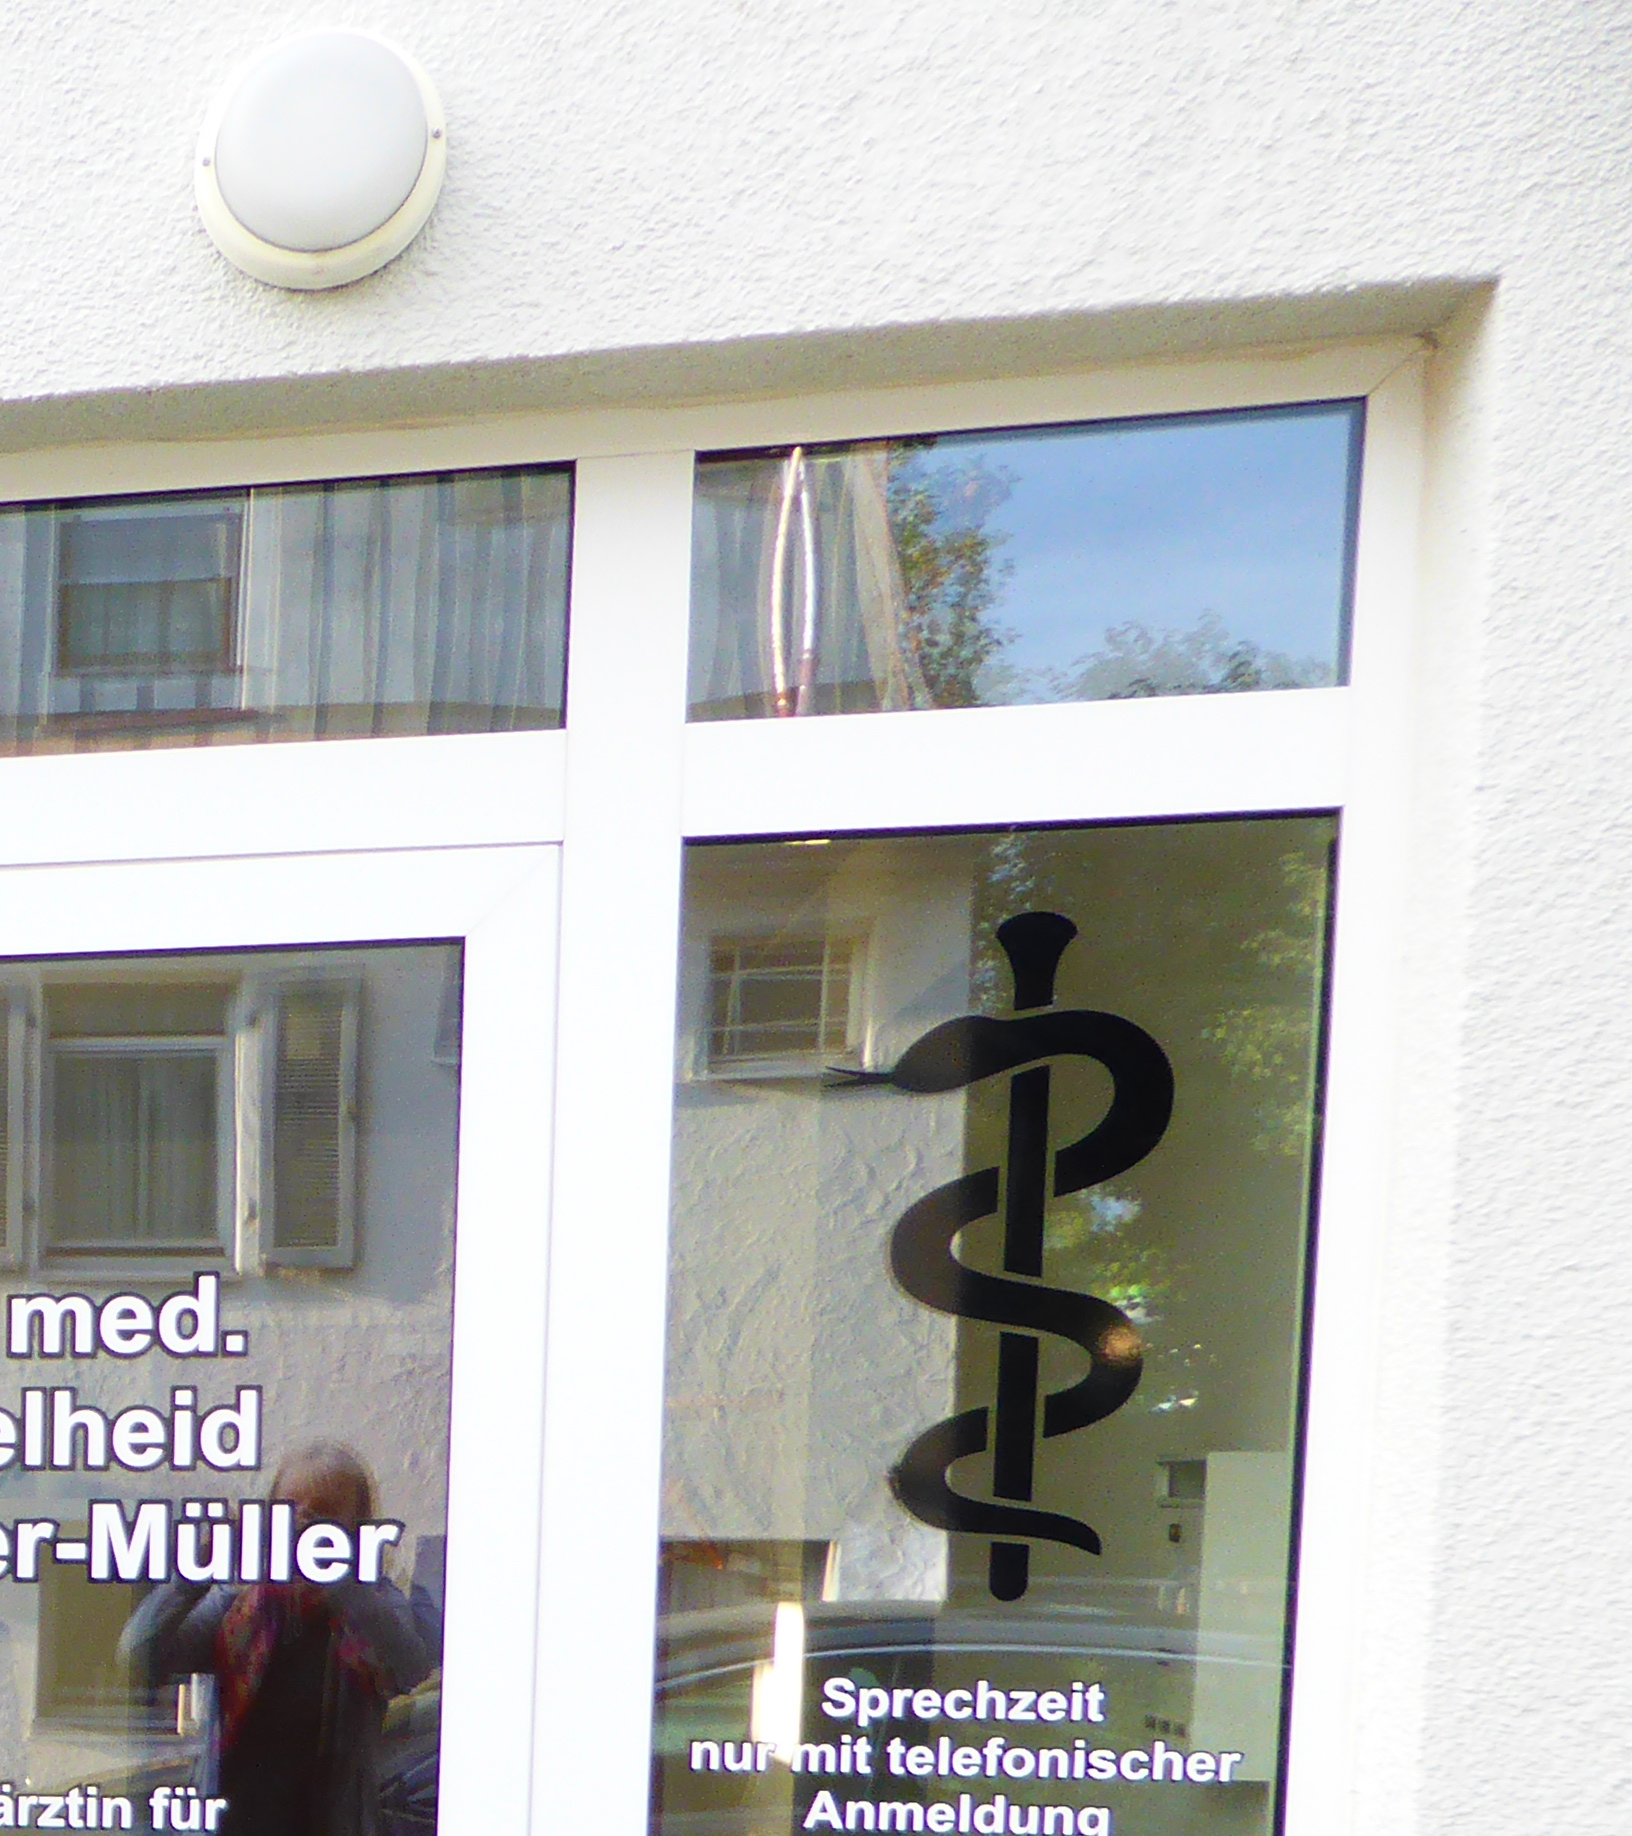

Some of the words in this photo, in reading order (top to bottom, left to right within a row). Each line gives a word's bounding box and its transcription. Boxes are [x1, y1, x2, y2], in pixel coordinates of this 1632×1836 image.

[5, 1271, 249, 1357] med.
[820, 1676, 1106, 1728] Sprechzeit
[690, 1737, 778, 1773] nur
[787, 1732, 873, 1775] mit
[885, 1735, 1247, 1784] telefonischer
[148, 1785, 228, 1831] für
